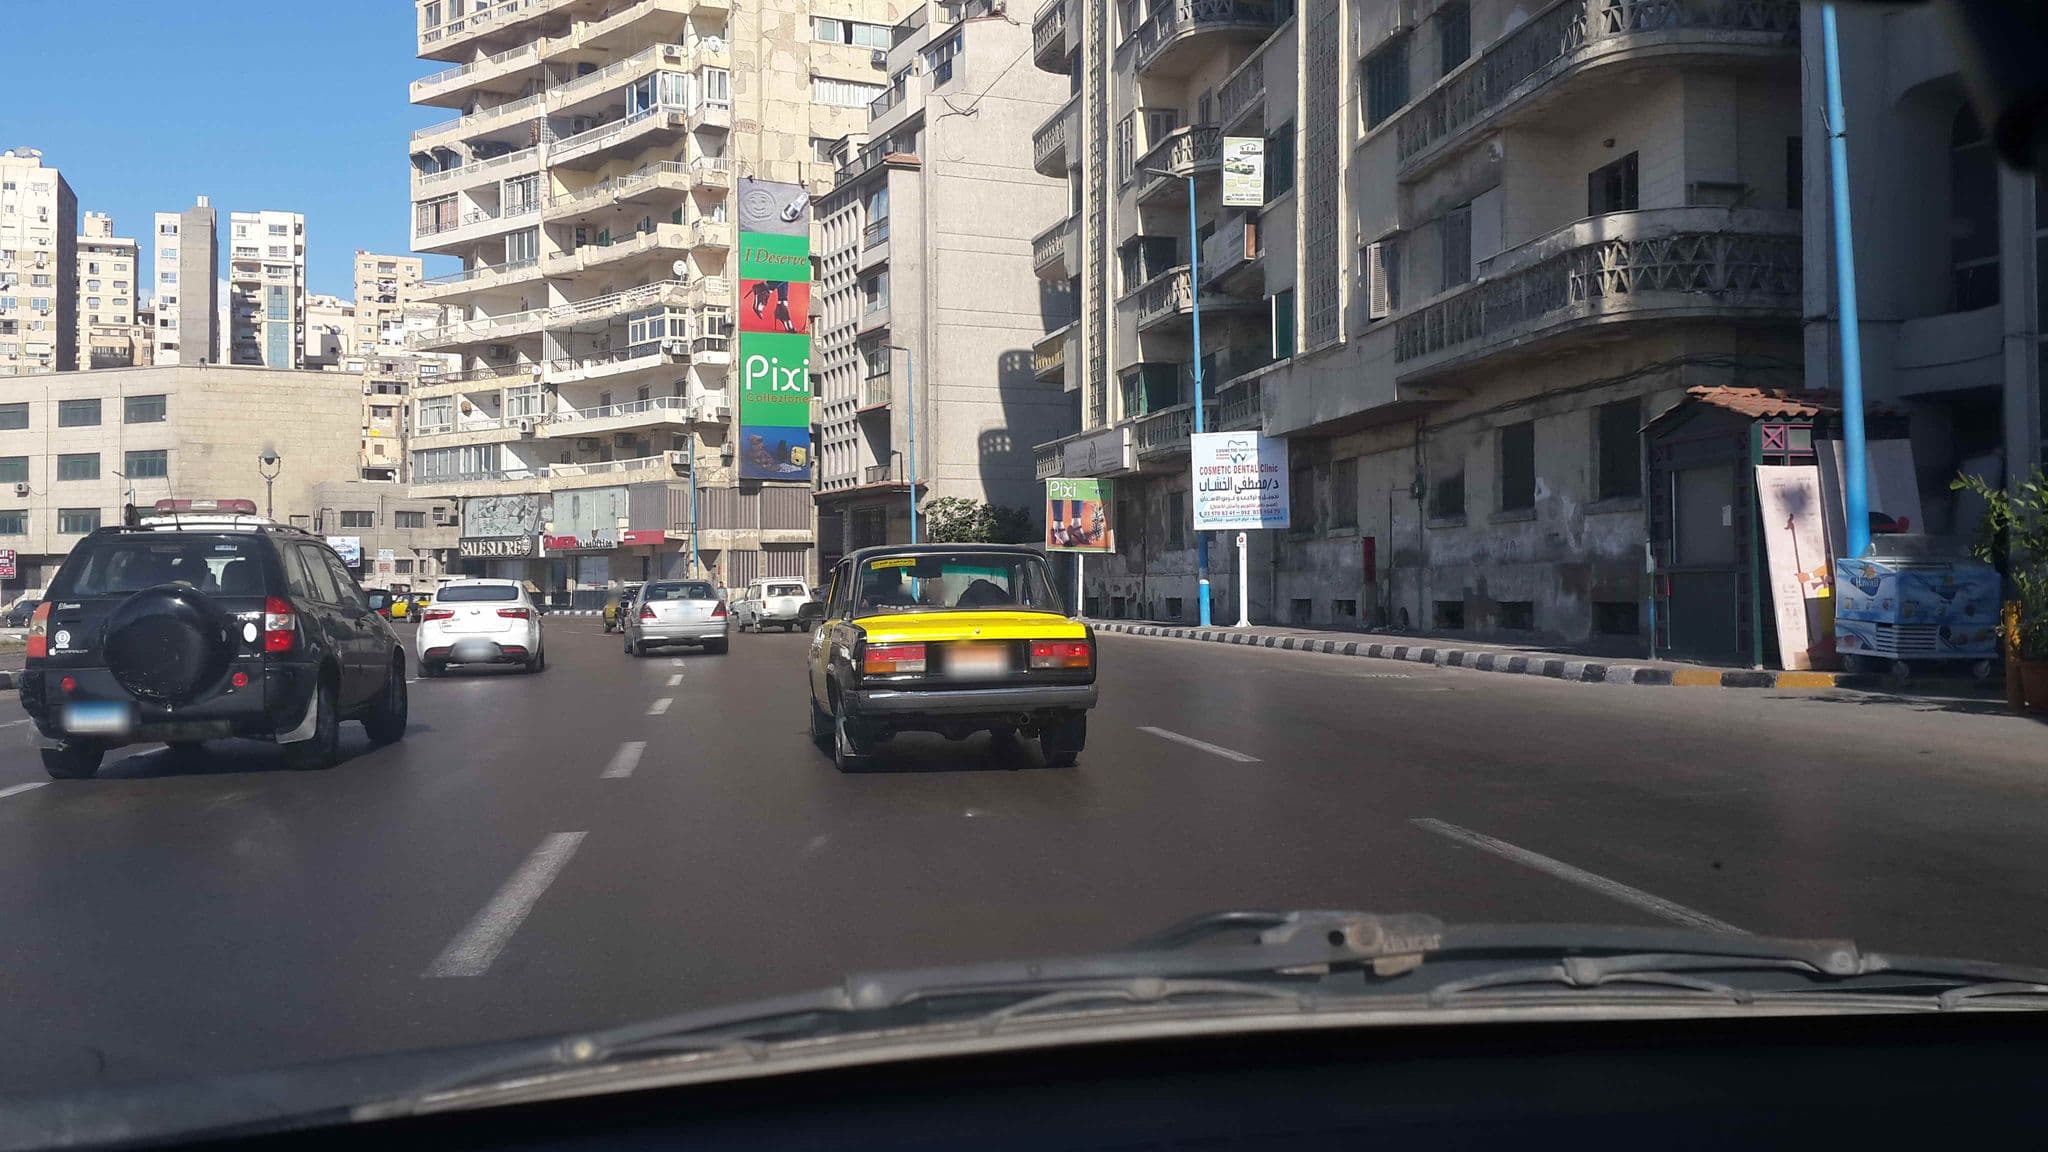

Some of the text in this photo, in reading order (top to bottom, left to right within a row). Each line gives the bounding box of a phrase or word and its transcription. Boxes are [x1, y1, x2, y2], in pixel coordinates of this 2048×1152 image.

[744, 247, 807, 266] I Deserve
[745, 354, 810, 393] Pixi
[1199, 463, 1279, 476] COSMETIC DENTAL Clinic
[1049, 480, 1078, 498] Pixi
